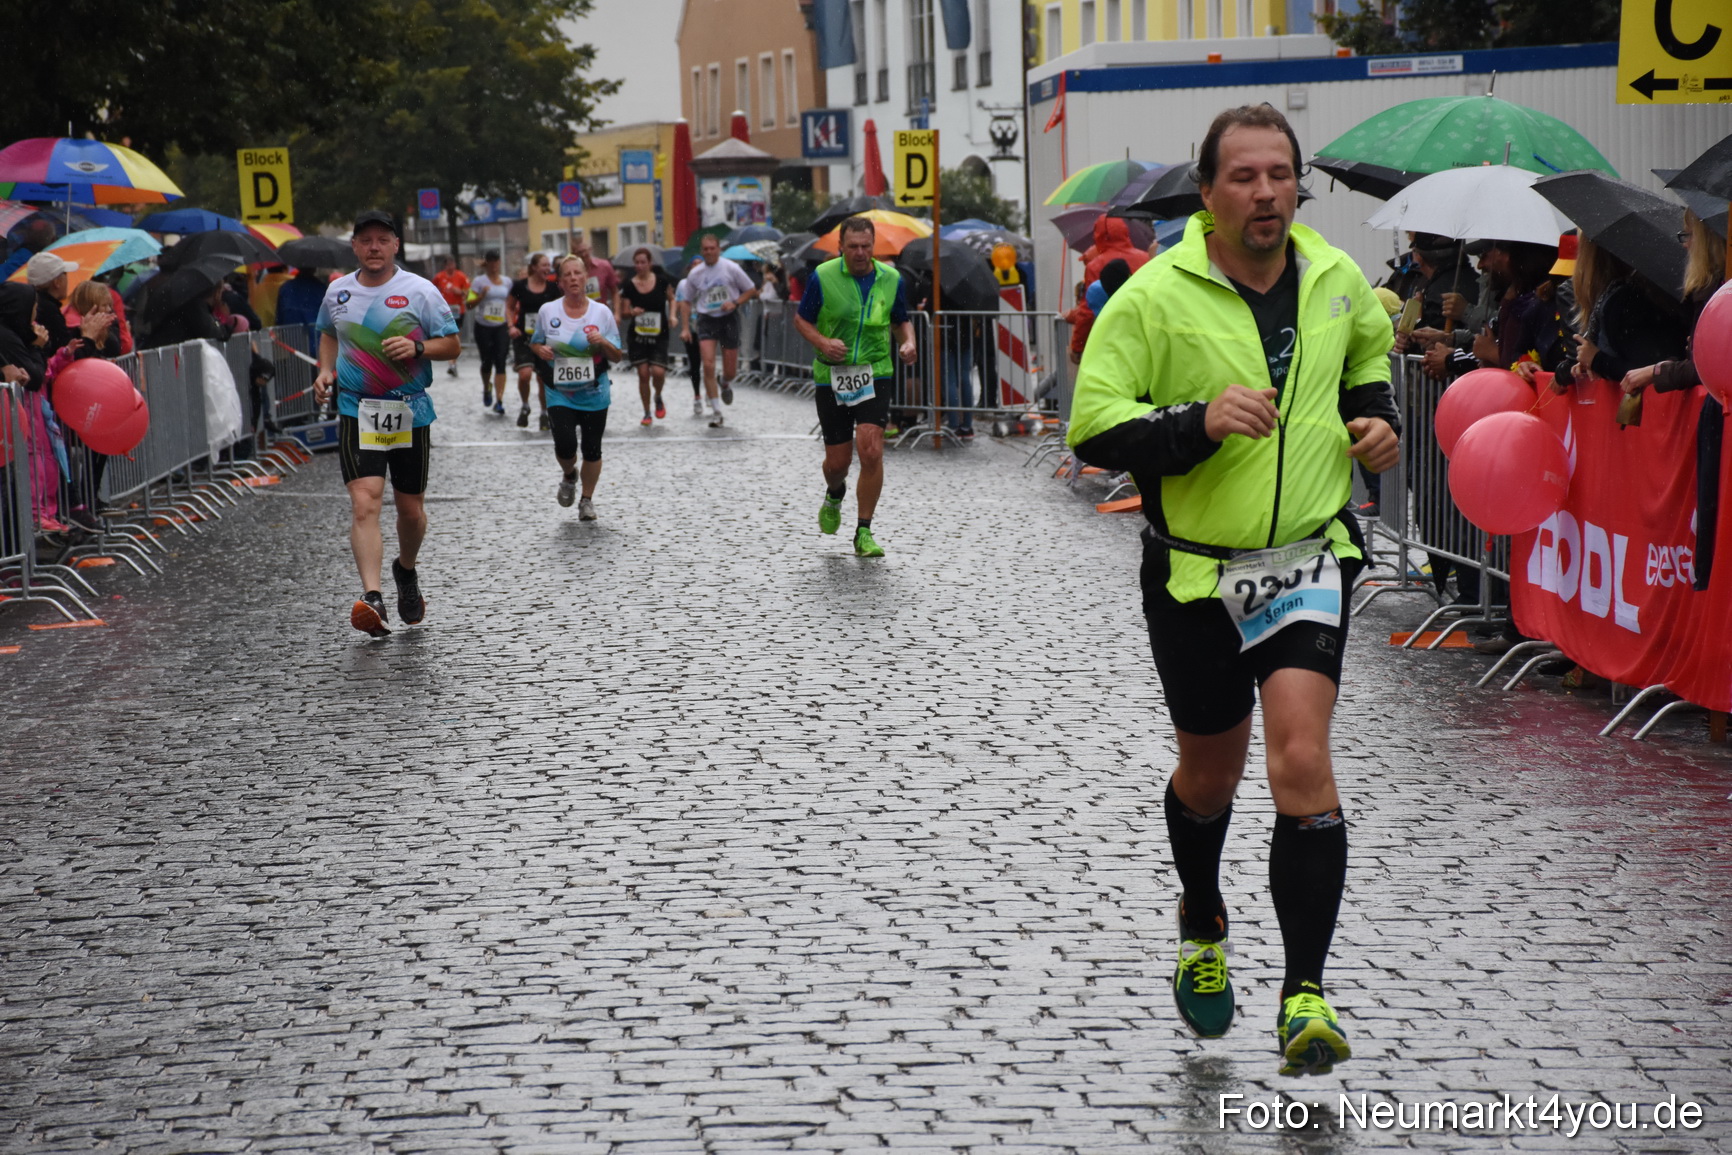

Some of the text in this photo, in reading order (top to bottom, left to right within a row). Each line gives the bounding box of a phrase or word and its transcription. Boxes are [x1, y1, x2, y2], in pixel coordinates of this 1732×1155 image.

[1654, 0, 1722, 61] C
[807, 115, 844, 149] KL
[899, 133, 934, 146] Block
[244, 151, 283, 166] Block
[906, 153, 928, 189] D
[253, 172, 279, 208] D
[558, 366, 591, 381] 2664
[837, 372, 870, 391] 2360
[371, 412, 402, 431] 141
[375, 436, 397, 446] Holger
